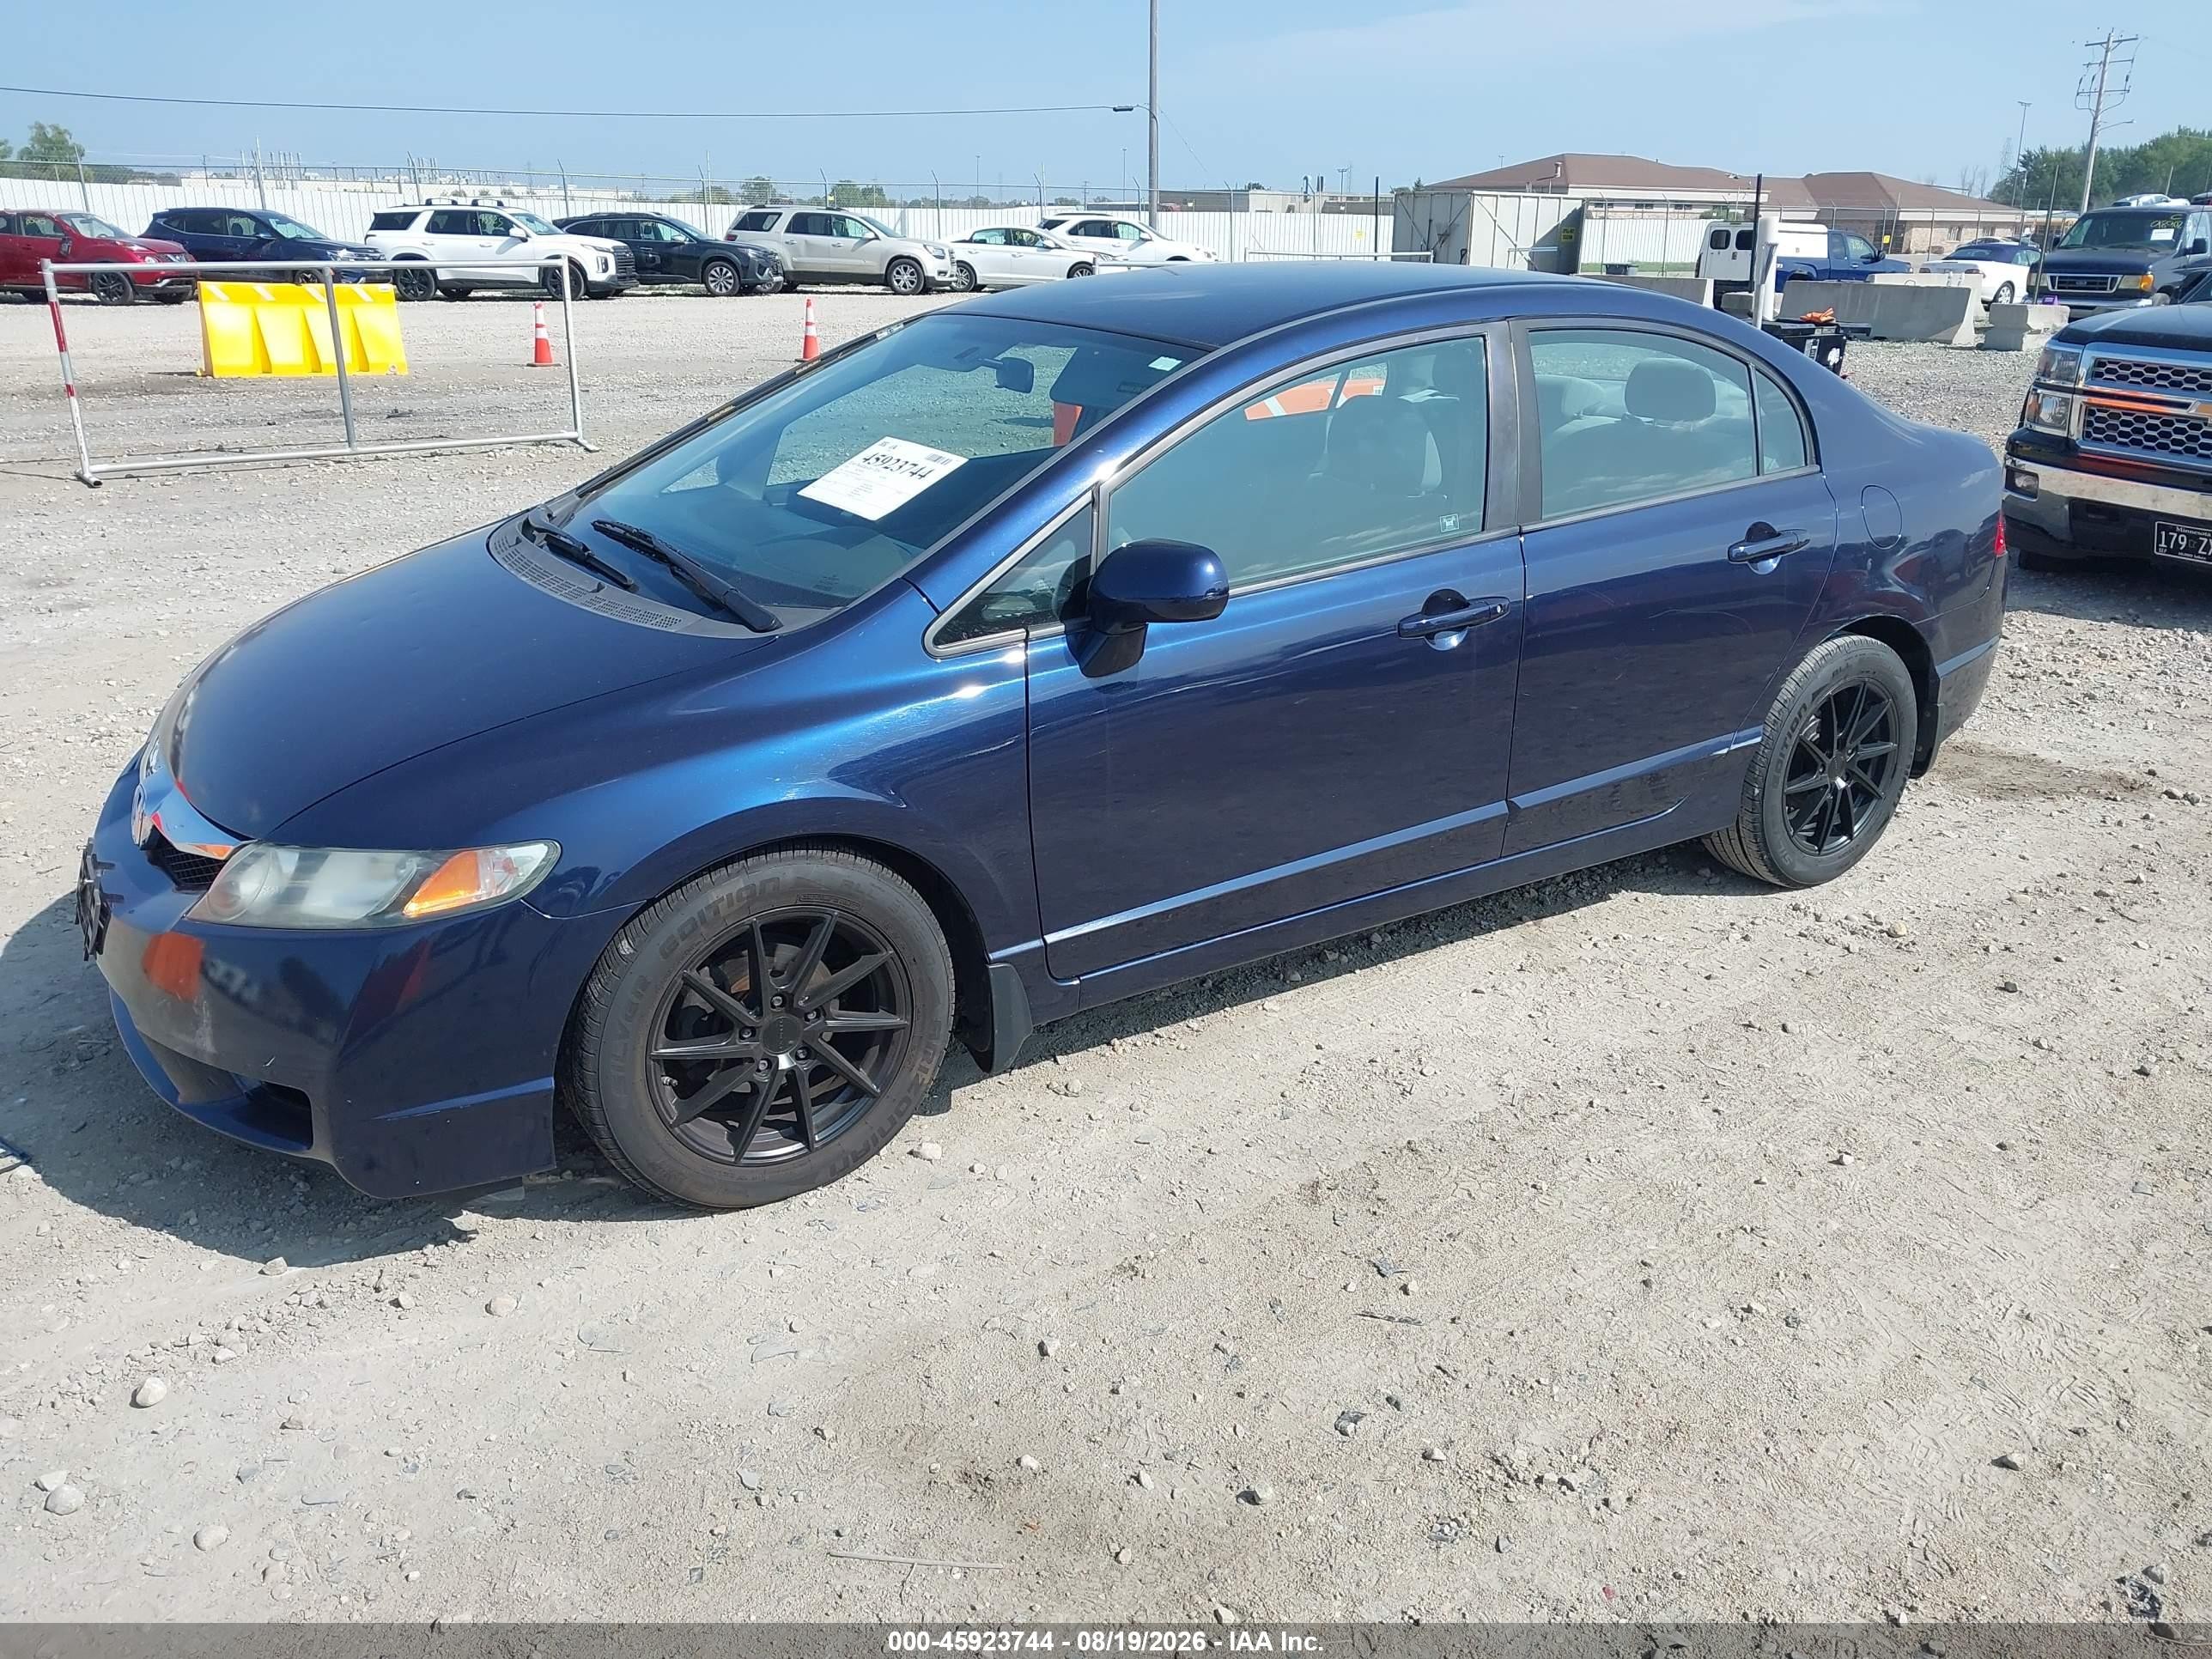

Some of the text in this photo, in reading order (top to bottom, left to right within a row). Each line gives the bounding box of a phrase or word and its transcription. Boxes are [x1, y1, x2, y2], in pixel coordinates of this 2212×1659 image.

[862, 453, 934, 480] 45923744
[2158, 531, 2187, 550] 179
[2176, 526, 2211, 537] Minnesota
